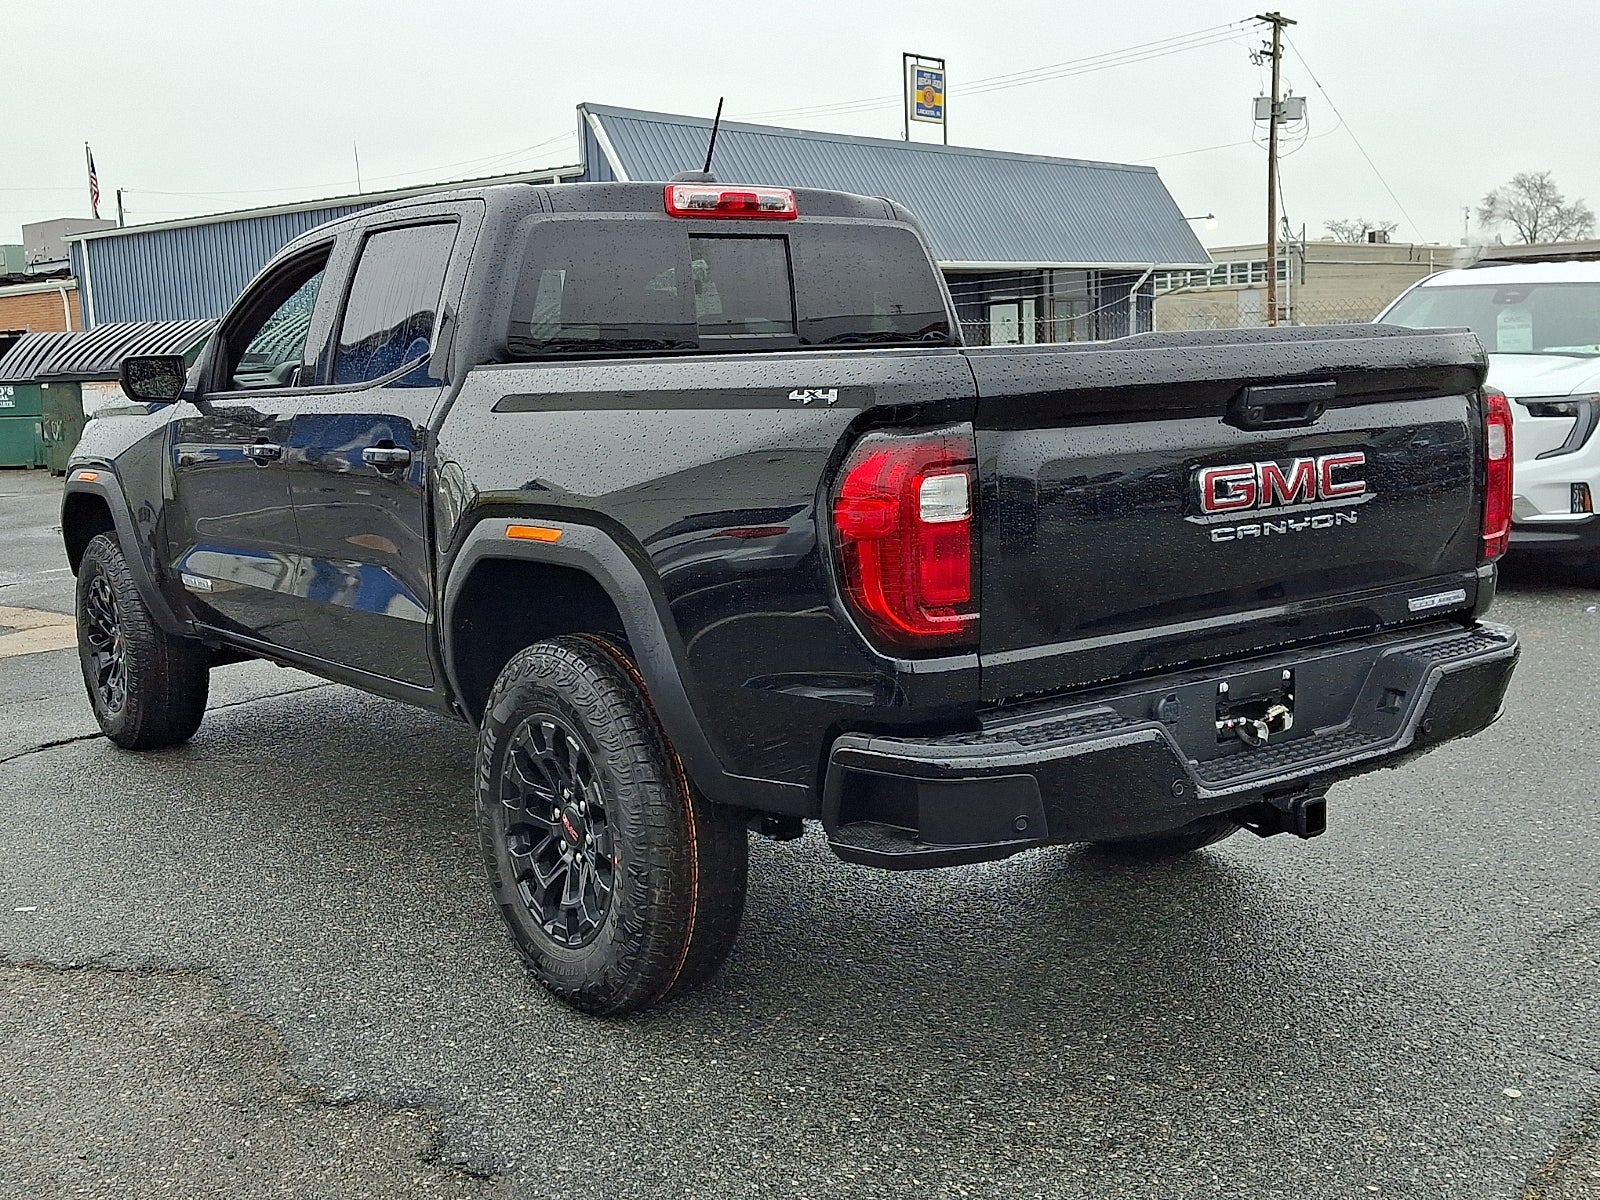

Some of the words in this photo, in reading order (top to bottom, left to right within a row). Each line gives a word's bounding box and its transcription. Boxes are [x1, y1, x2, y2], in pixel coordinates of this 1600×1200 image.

[1200, 451, 1367, 513] GMC
[1210, 510, 1358, 543] CANYON
[562, 813, 579, 841] GMC
